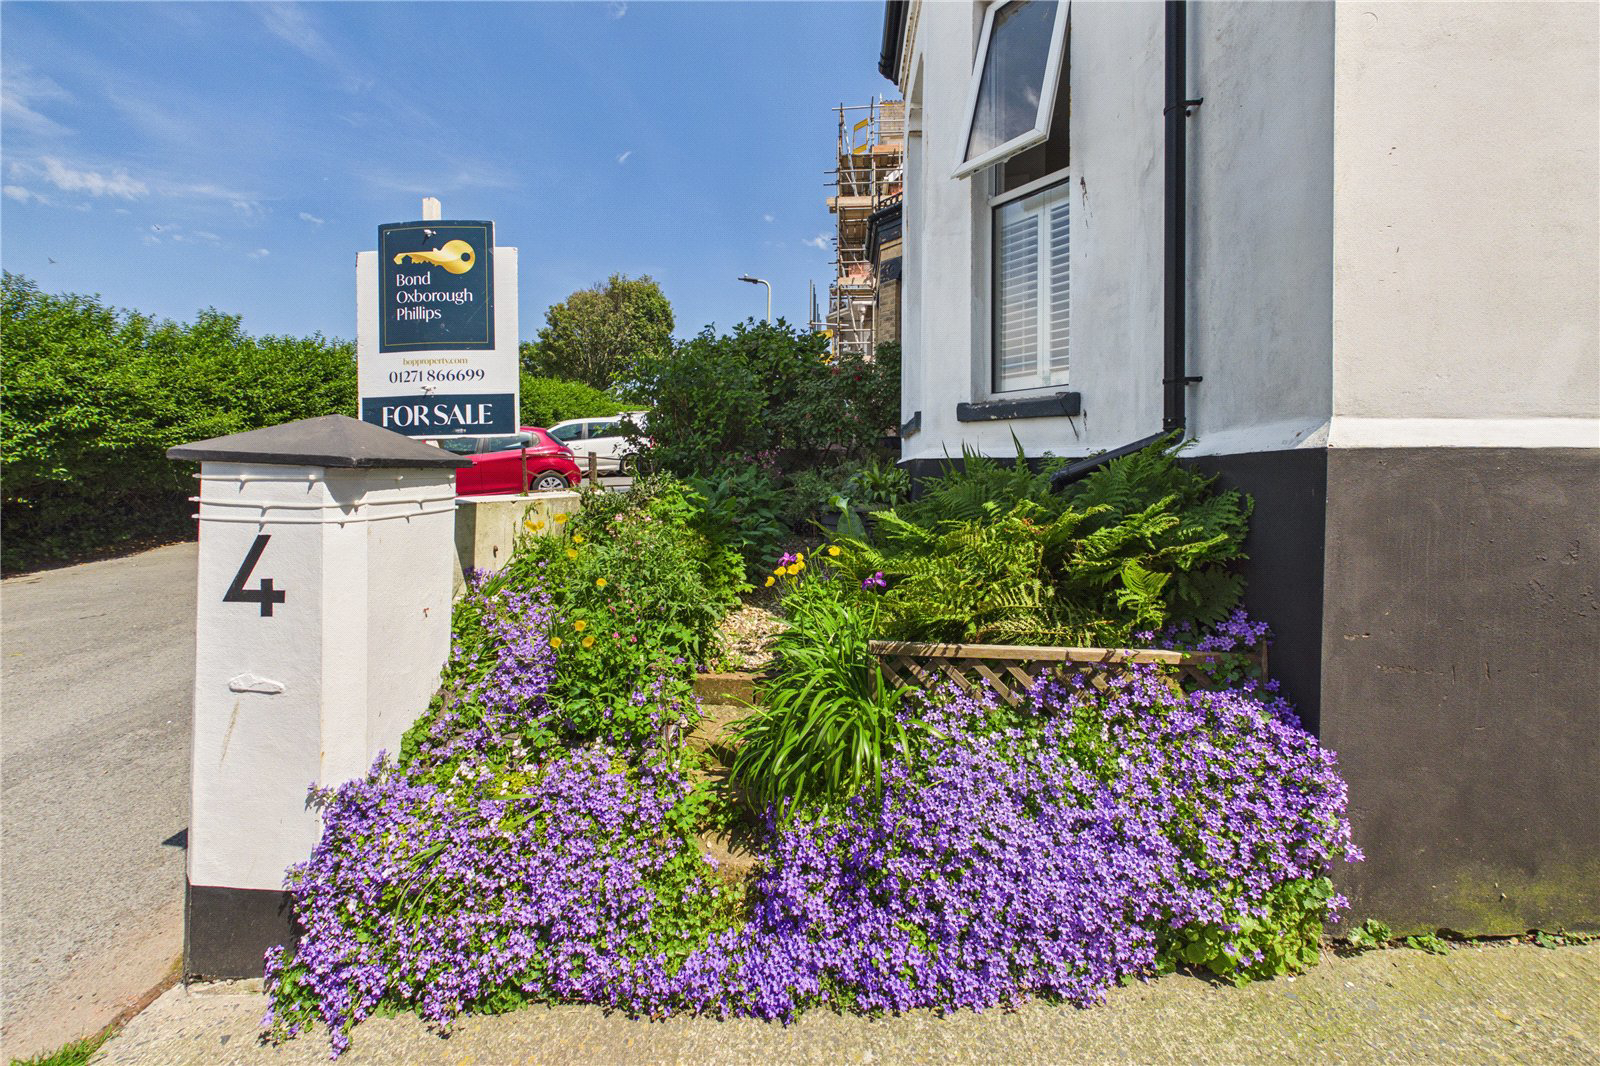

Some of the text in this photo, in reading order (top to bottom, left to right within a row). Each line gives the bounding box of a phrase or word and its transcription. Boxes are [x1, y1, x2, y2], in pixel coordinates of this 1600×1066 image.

[396, 271, 431, 287] Bond
[396, 288, 473, 305] Oxborough
[396, 307, 442, 323] Phillips
[389, 368, 485, 384] 01271 866699
[382, 404, 493, 427] FOR SALE
[222, 534, 285, 617] 4
